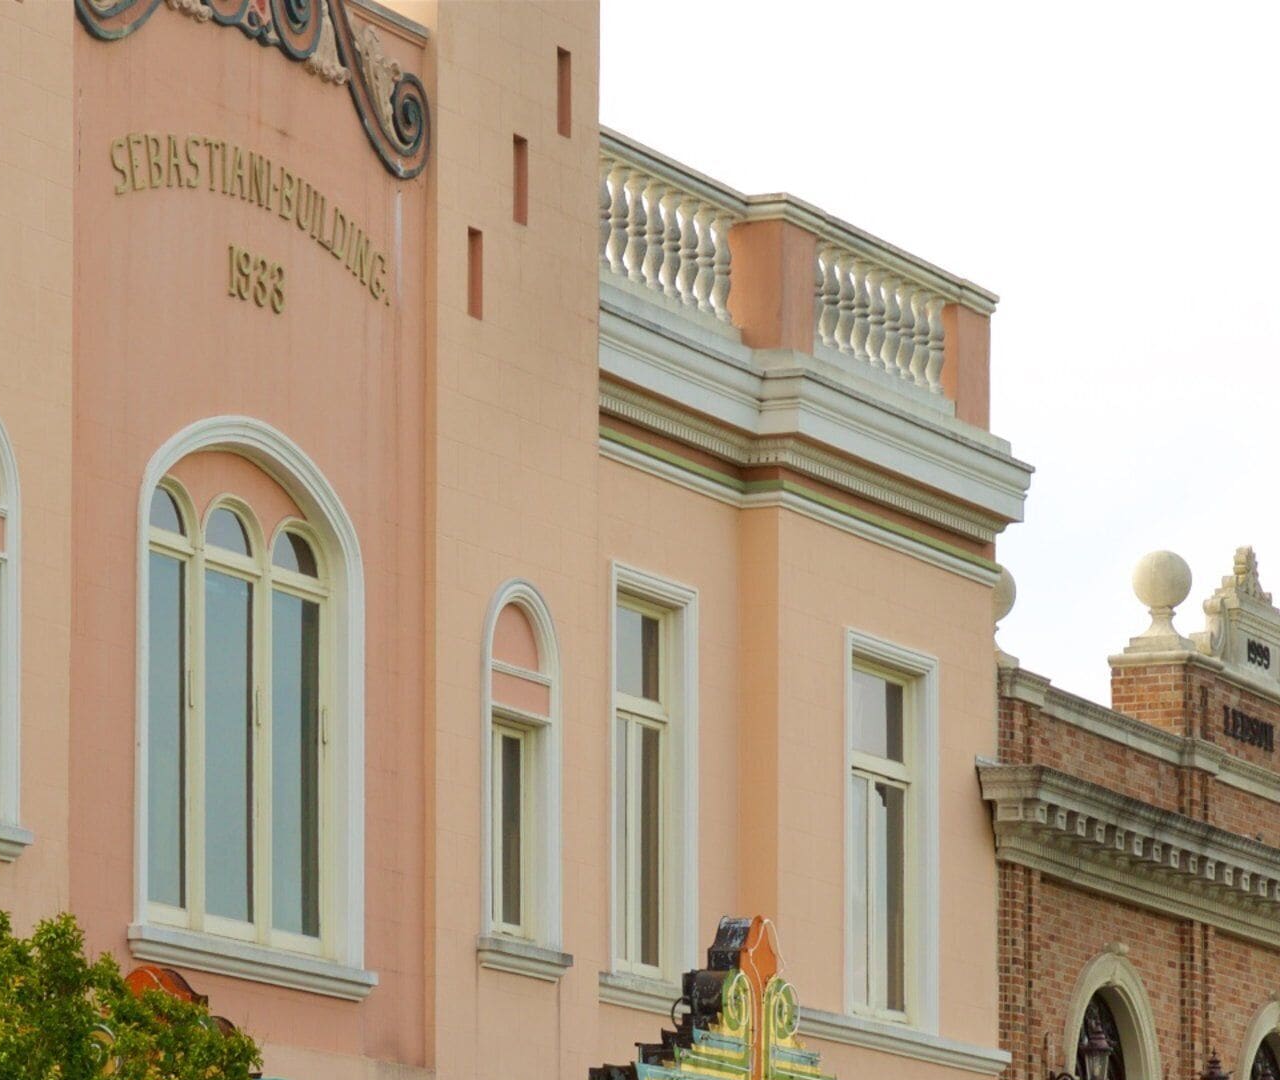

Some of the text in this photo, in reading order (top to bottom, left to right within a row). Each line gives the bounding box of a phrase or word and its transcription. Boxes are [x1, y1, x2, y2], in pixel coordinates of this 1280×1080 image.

[110, 132, 272, 211] SEBASTIANI
[228, 242, 286, 314] 1933
[1247, 638, 1270, 670] 1999
[1223, 704, 1274, 752] LEDSON
